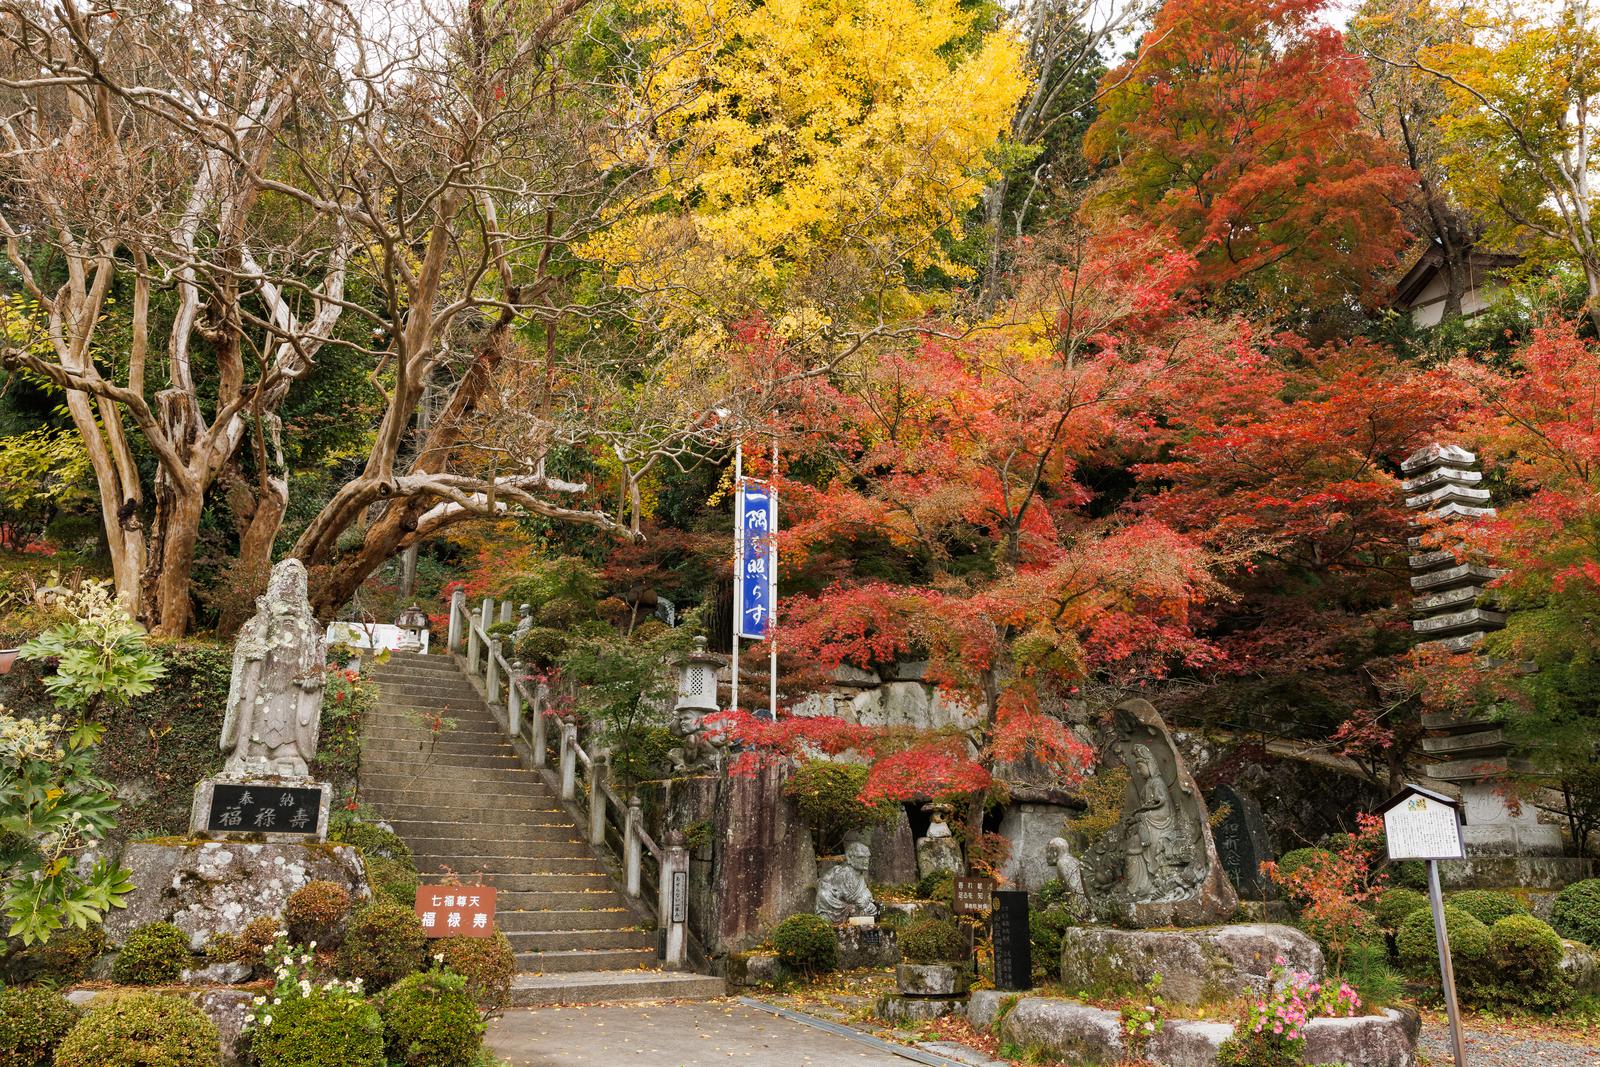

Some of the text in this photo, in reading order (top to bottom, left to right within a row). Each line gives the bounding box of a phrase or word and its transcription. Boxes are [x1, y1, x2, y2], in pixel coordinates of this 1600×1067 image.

[745, 493, 768, 624] 一隅を照らす
[238, 790, 294, 807] 奉納
[431, 894, 480, 907] 七福尊天
[422, 911, 488, 928] 福禄寿
